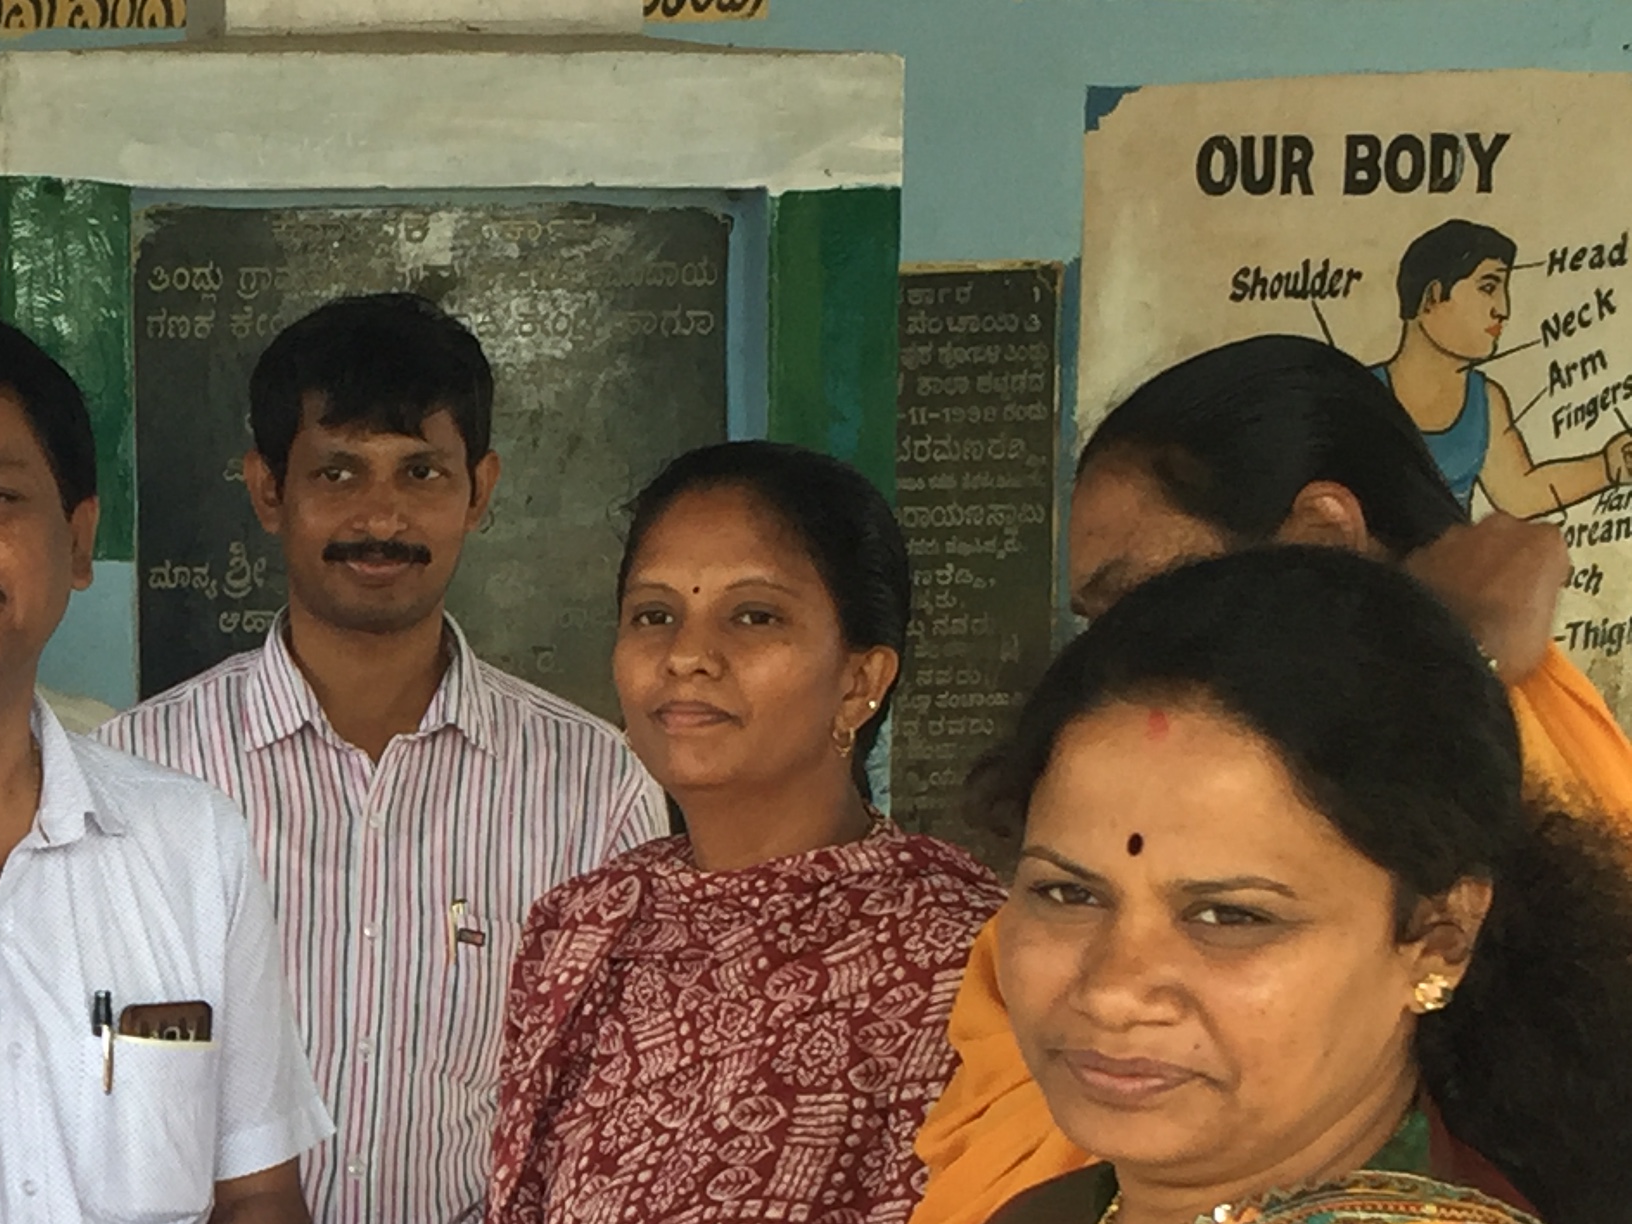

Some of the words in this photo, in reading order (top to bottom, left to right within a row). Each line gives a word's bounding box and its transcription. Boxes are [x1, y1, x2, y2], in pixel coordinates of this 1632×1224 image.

[1196, 134, 1314, 195] OUR
[1343, 132, 1511, 195] BODY
[1229, 258, 1362, 302] Shoulder
[1547, 231, 1628, 277] Head
[1540, 288, 1617, 348] Neck
[1548, 349, 1608, 398] Arm
[1552, 374, 1632, 439] Fingers
[223, 541, 267, 598] ಶ್ರೀ
